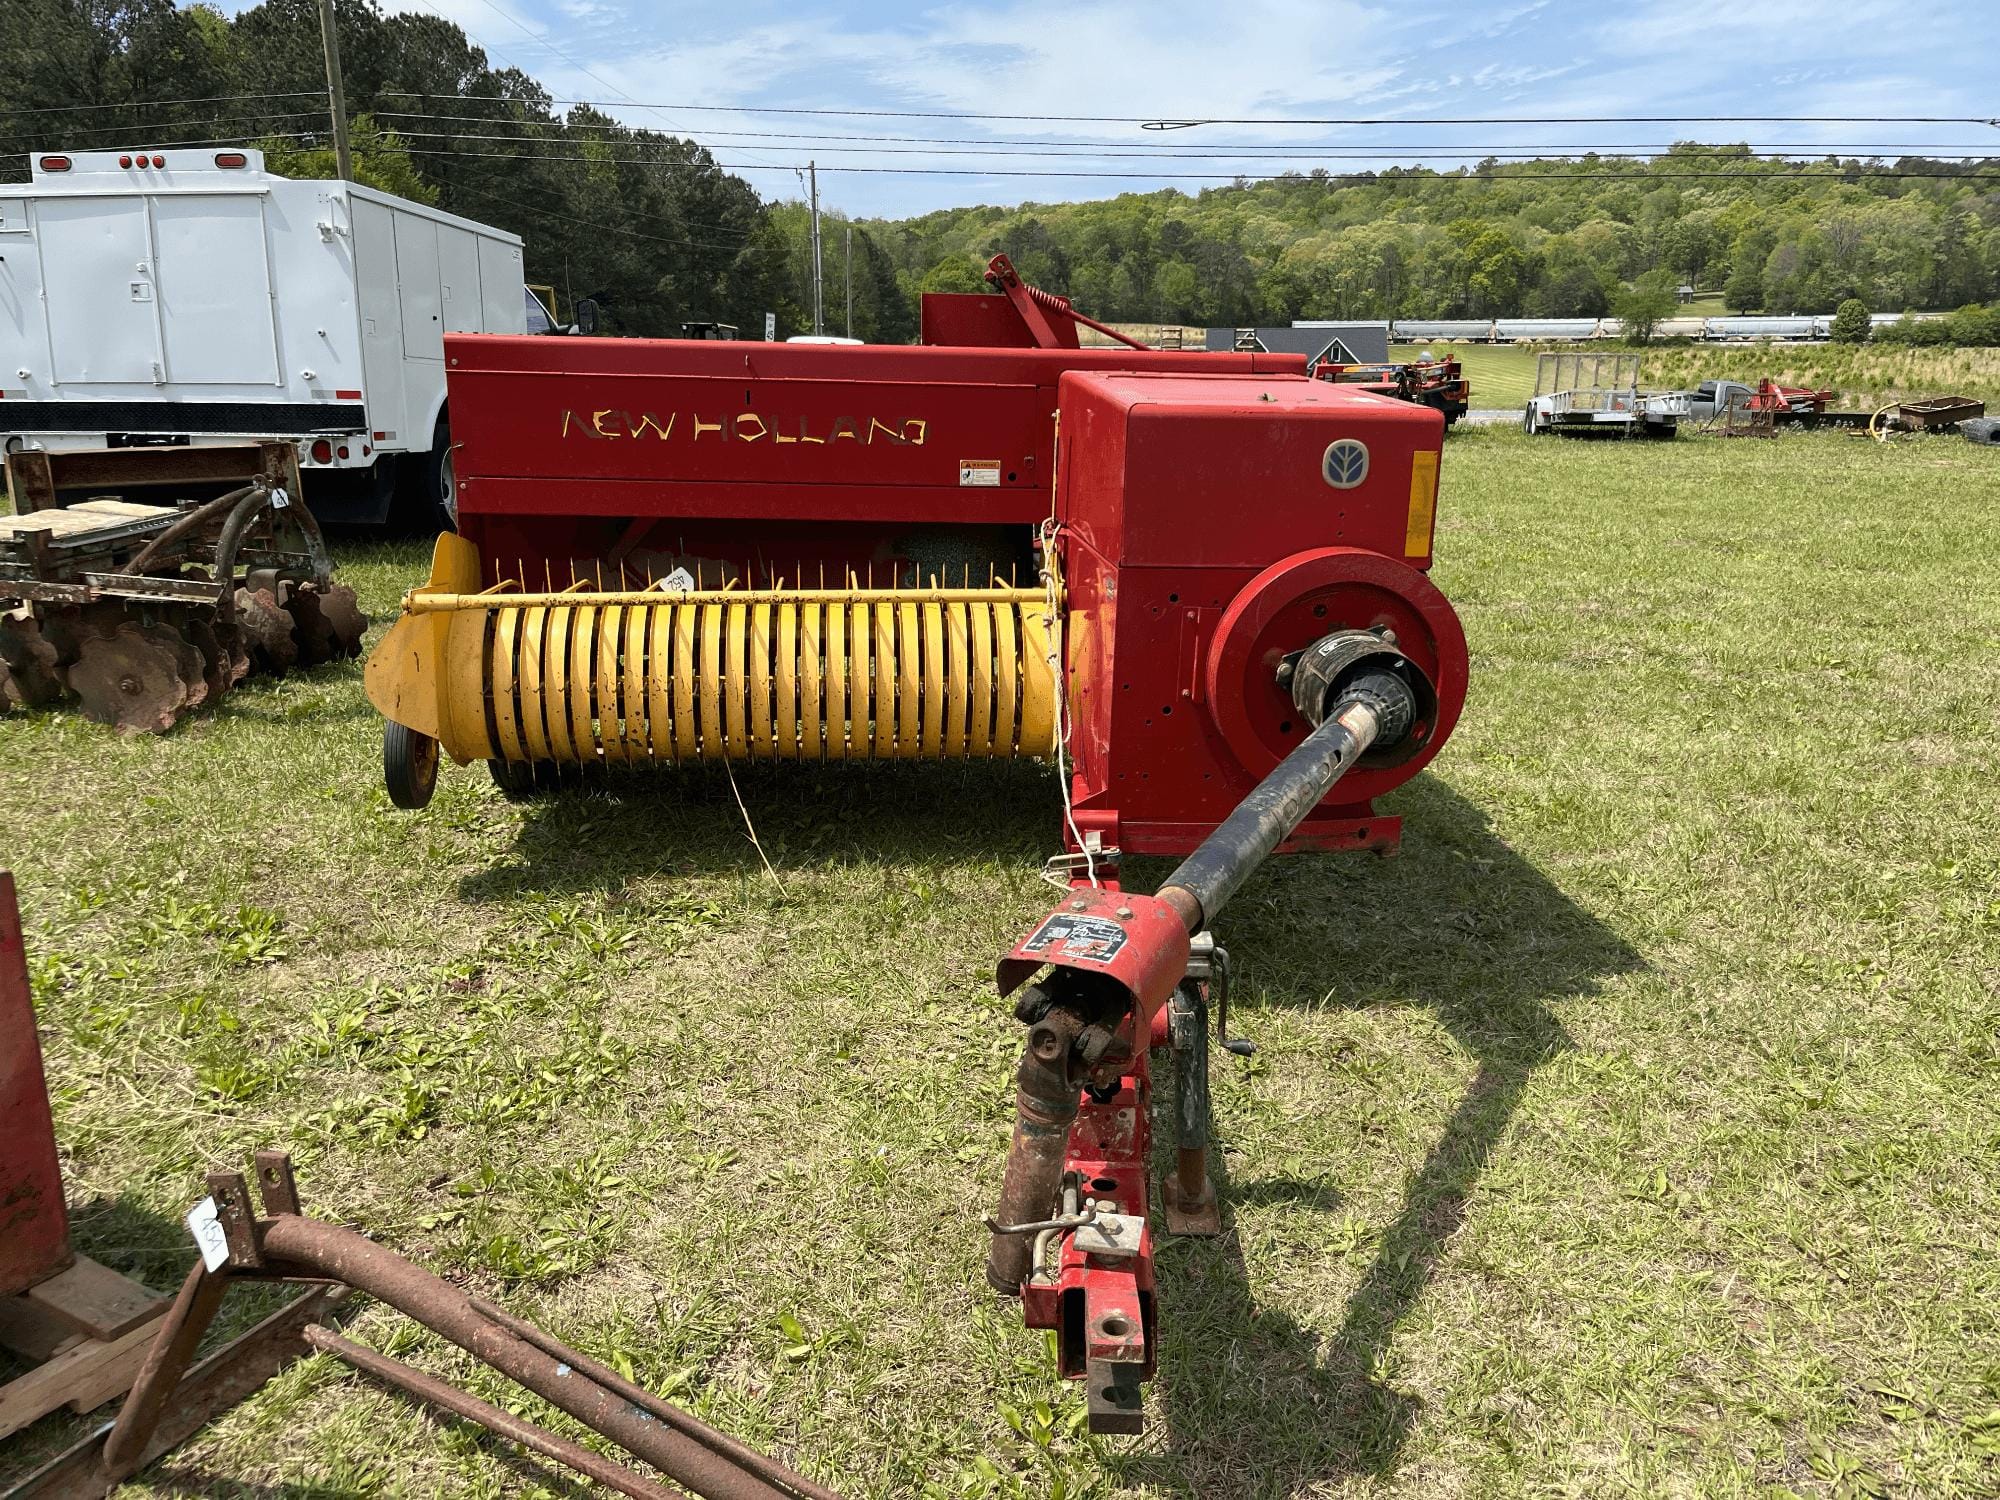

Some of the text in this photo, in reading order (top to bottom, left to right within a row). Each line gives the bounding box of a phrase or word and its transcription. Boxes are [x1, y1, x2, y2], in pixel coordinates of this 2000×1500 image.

[561, 409, 929, 446] NEW HOLLAND
[667, 575, 685, 591] 452
